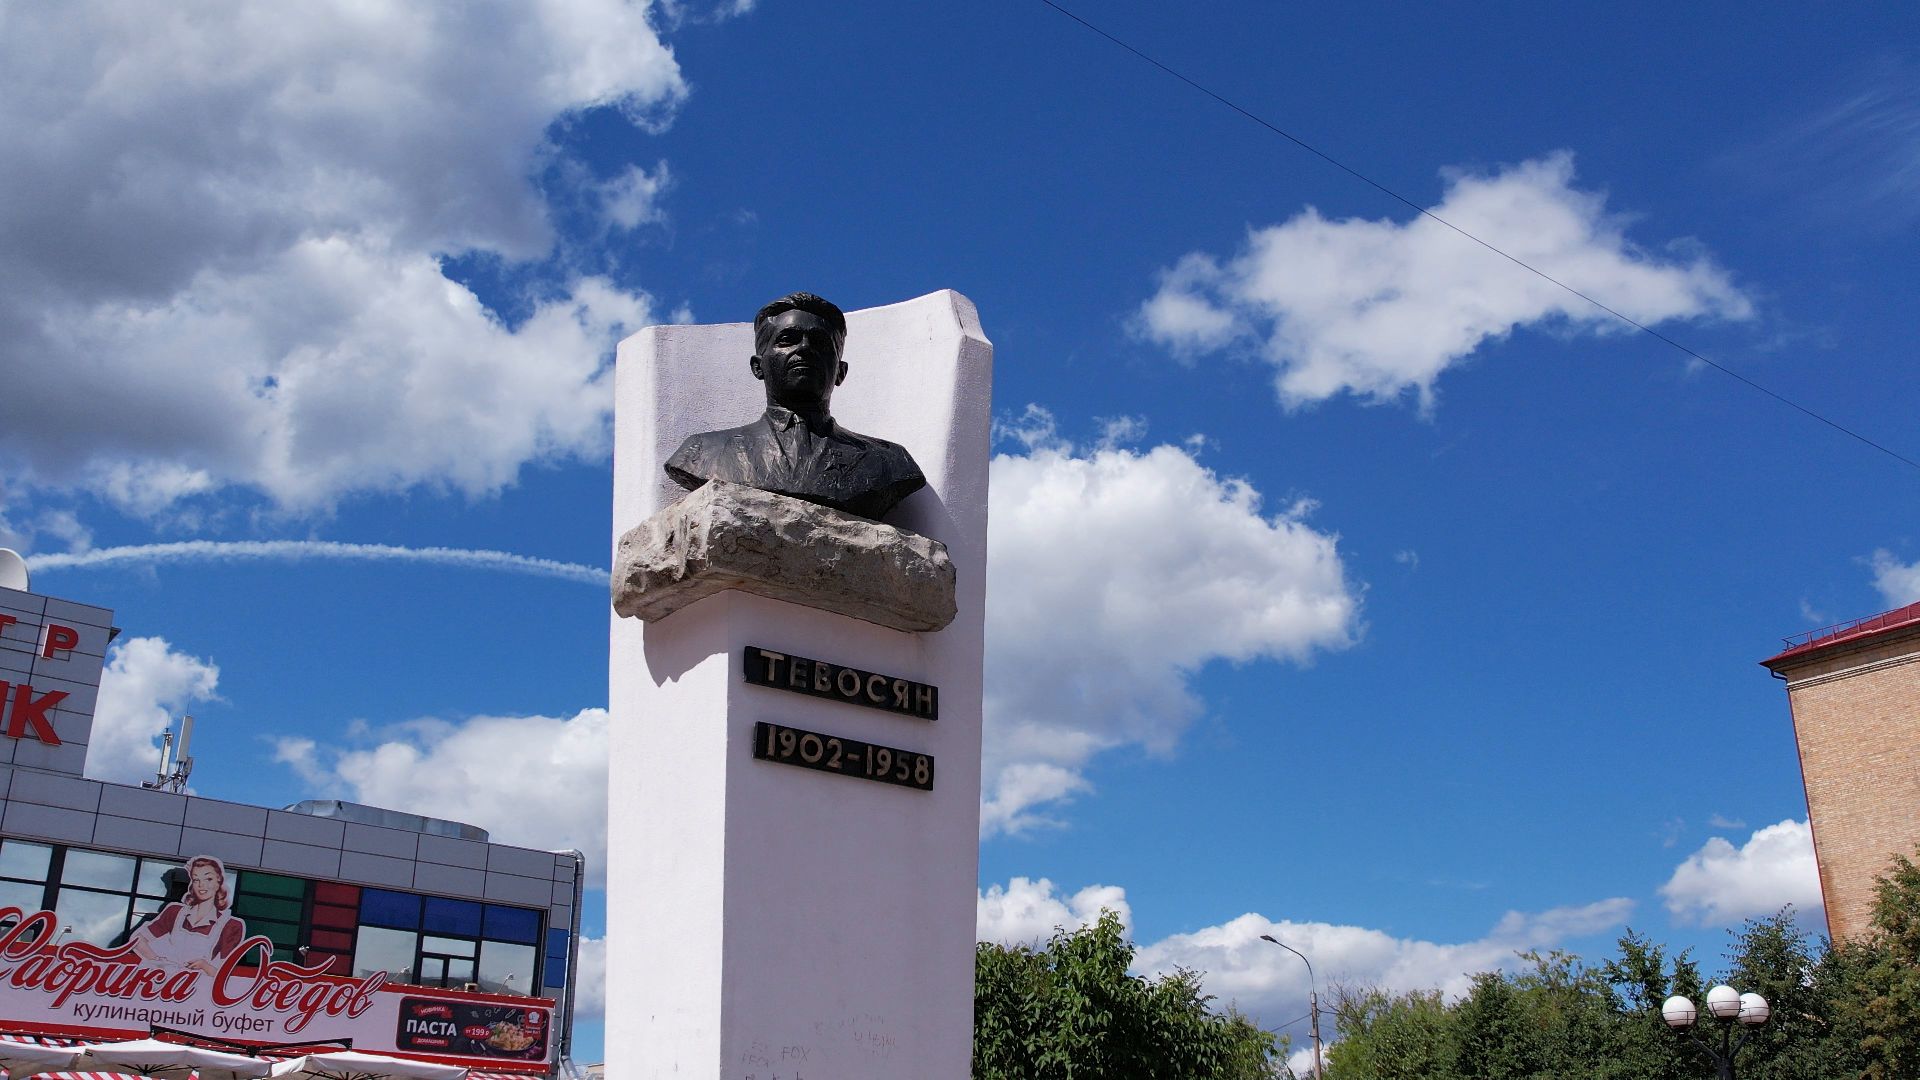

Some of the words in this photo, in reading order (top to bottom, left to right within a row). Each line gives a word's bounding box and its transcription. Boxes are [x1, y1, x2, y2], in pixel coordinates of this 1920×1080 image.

[760, 650, 932, 714] ТЕВОСЯН
[766, 724, 930, 784] 1902-1958
[212, 936, 387, 1033] Обедов
[73, 1003, 204, 1027] кулинарный
[212, 1011, 274, 1034] буфет
[406, 1019, 457, 1037] ПАСТА
[471, 1028, 485, 1036] 199
